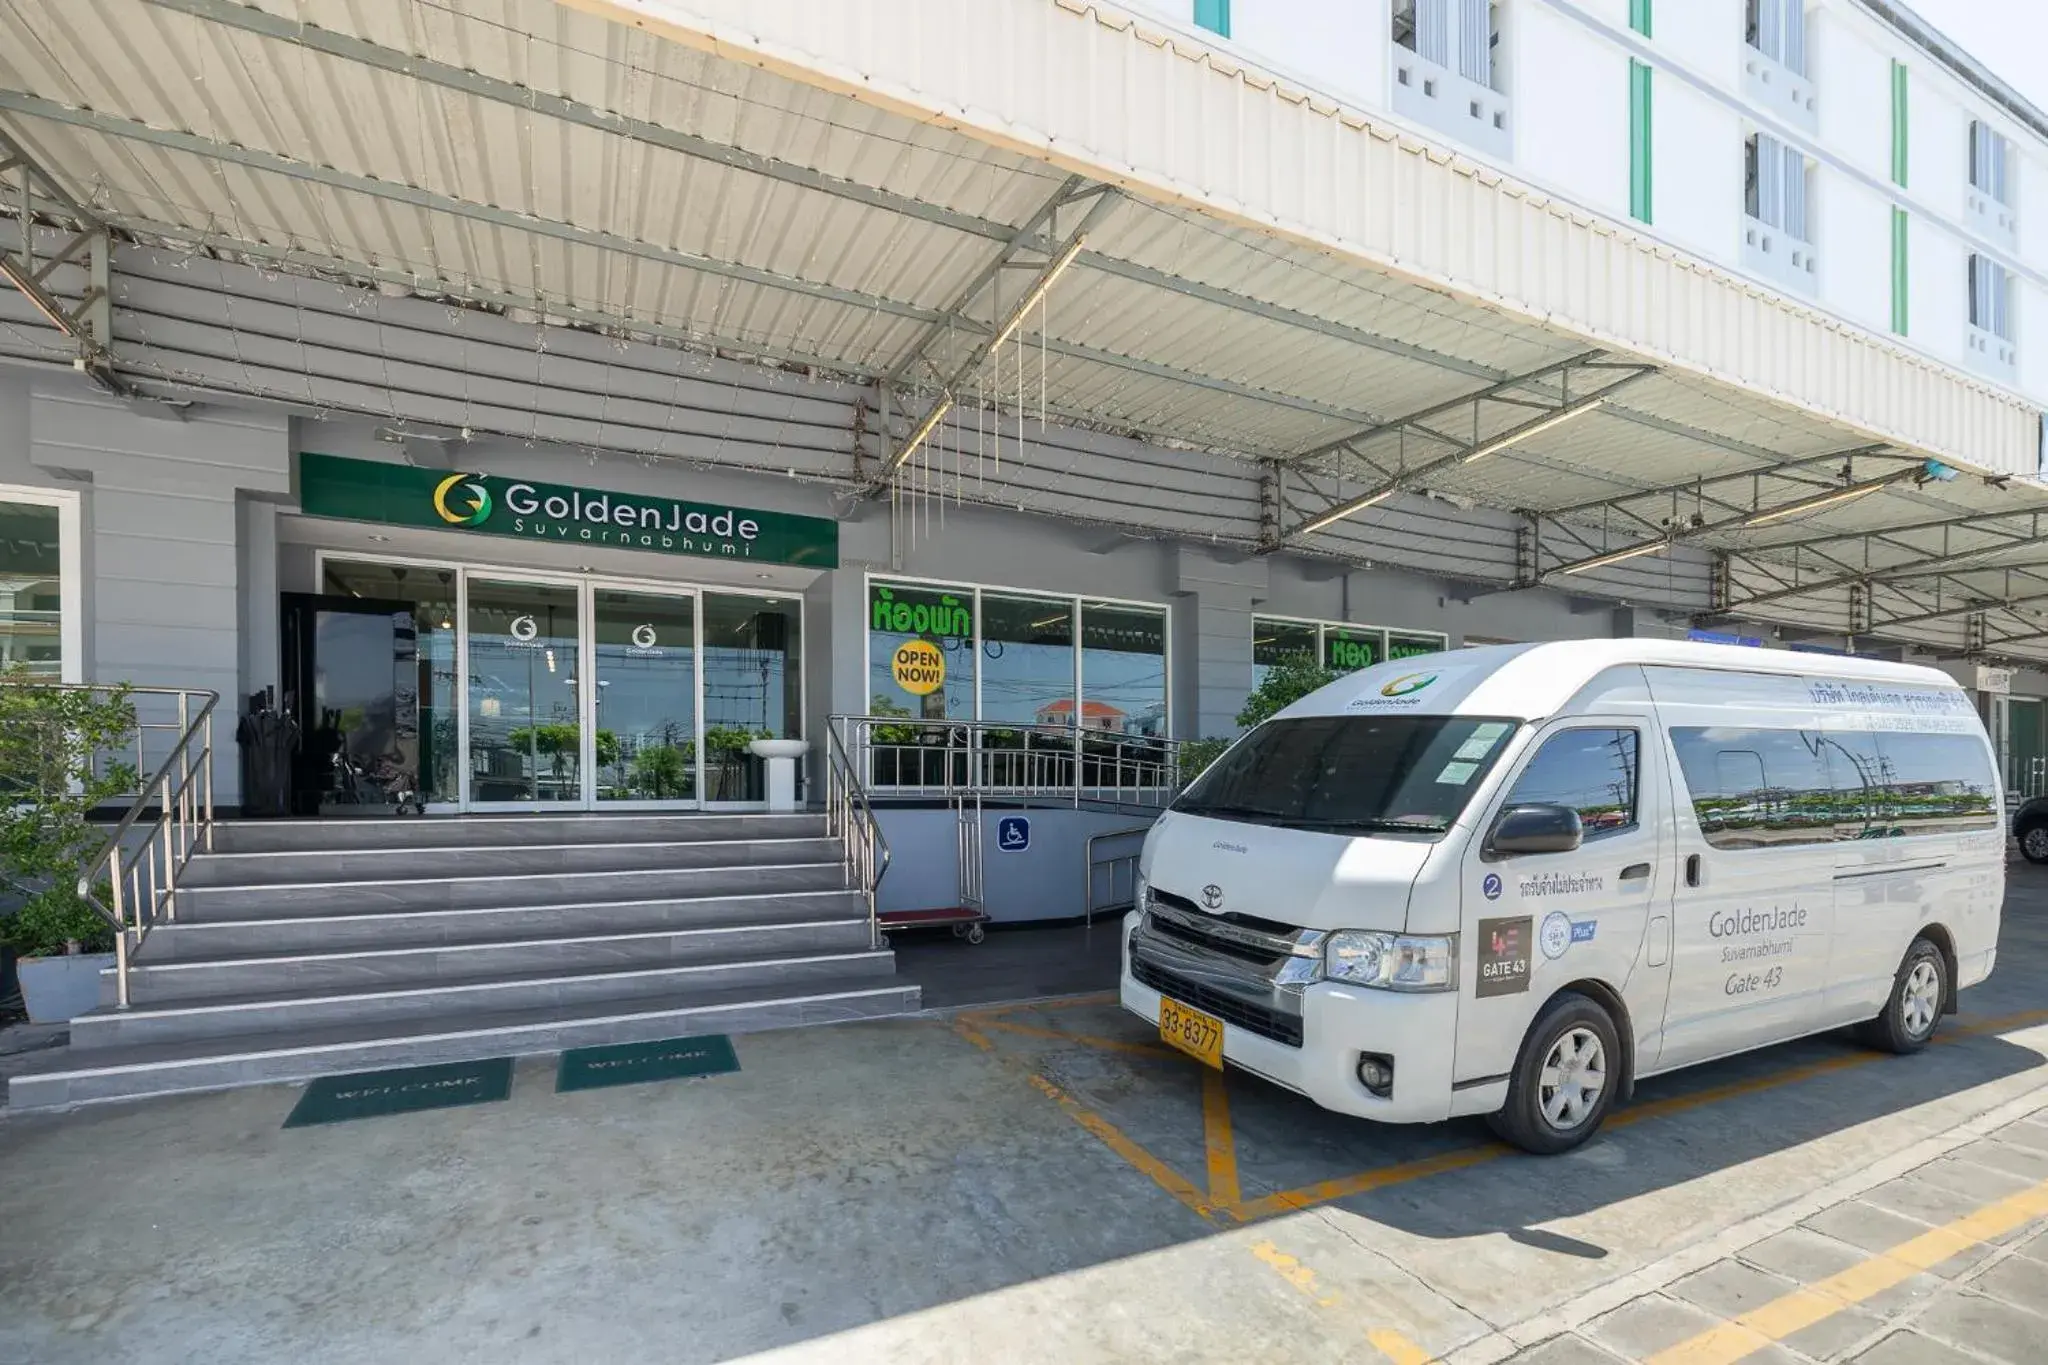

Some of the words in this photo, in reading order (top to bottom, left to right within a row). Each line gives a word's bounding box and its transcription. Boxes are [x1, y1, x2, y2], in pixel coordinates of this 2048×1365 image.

[505, 484, 759, 540] GoldenJade
[514, 518, 750, 556] Suvarnabhumi
[873, 587, 969, 637] ห้องพัก
[897, 649, 940, 667] OPEN
[897, 667, 940, 684] NOW!
[1486, 877, 1500, 897] 2
[1709, 901, 1808, 938] GoldenJade
[1721, 938, 1794, 963] Suvarnabhumi
[1483, 961, 1512, 977] GATE
[1513, 959, 1526, 974] 43
[1725, 973, 1760, 996] Gate
[1763, 966, 1783, 989] 43
[1163, 1007, 1218, 1052] 33-8377
